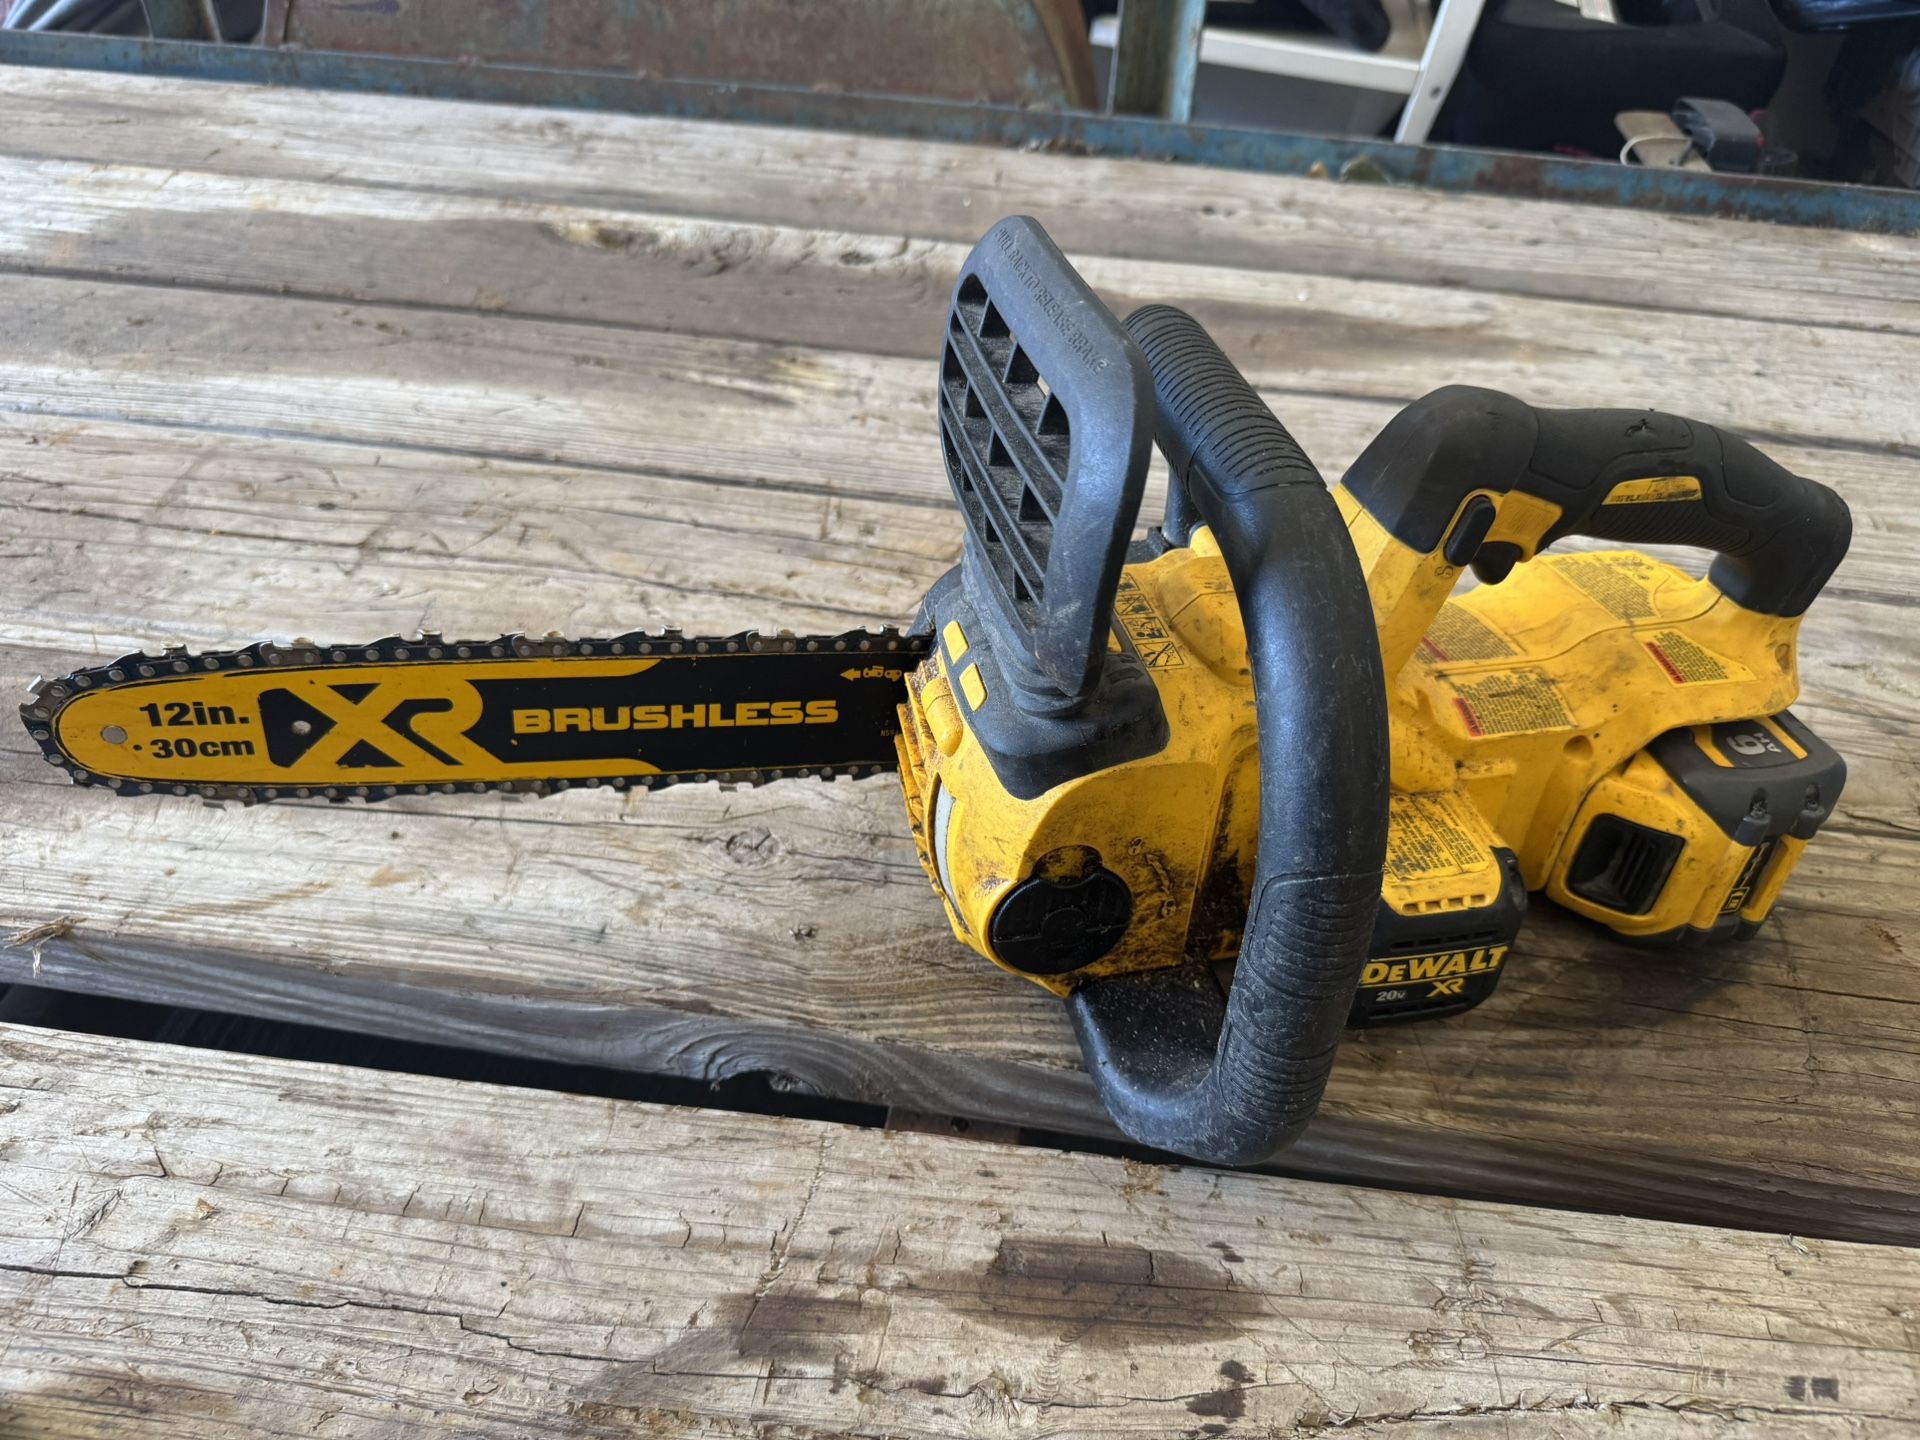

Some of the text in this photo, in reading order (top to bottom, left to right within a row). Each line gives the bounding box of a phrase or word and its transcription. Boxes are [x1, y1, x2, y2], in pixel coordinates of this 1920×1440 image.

[1033, 285, 1077, 337] RELEASE
[1067, 328, 1108, 375] BRAKE
[139, 702, 250, 727] 12in.
[283, 682, 504, 768] XR
[512, 701, 838, 734] BRUSHLESS
[150, 738, 255, 758] 30cm
[1359, 946, 1508, 985] DEWALT
[1426, 978, 1466, 998] XR
